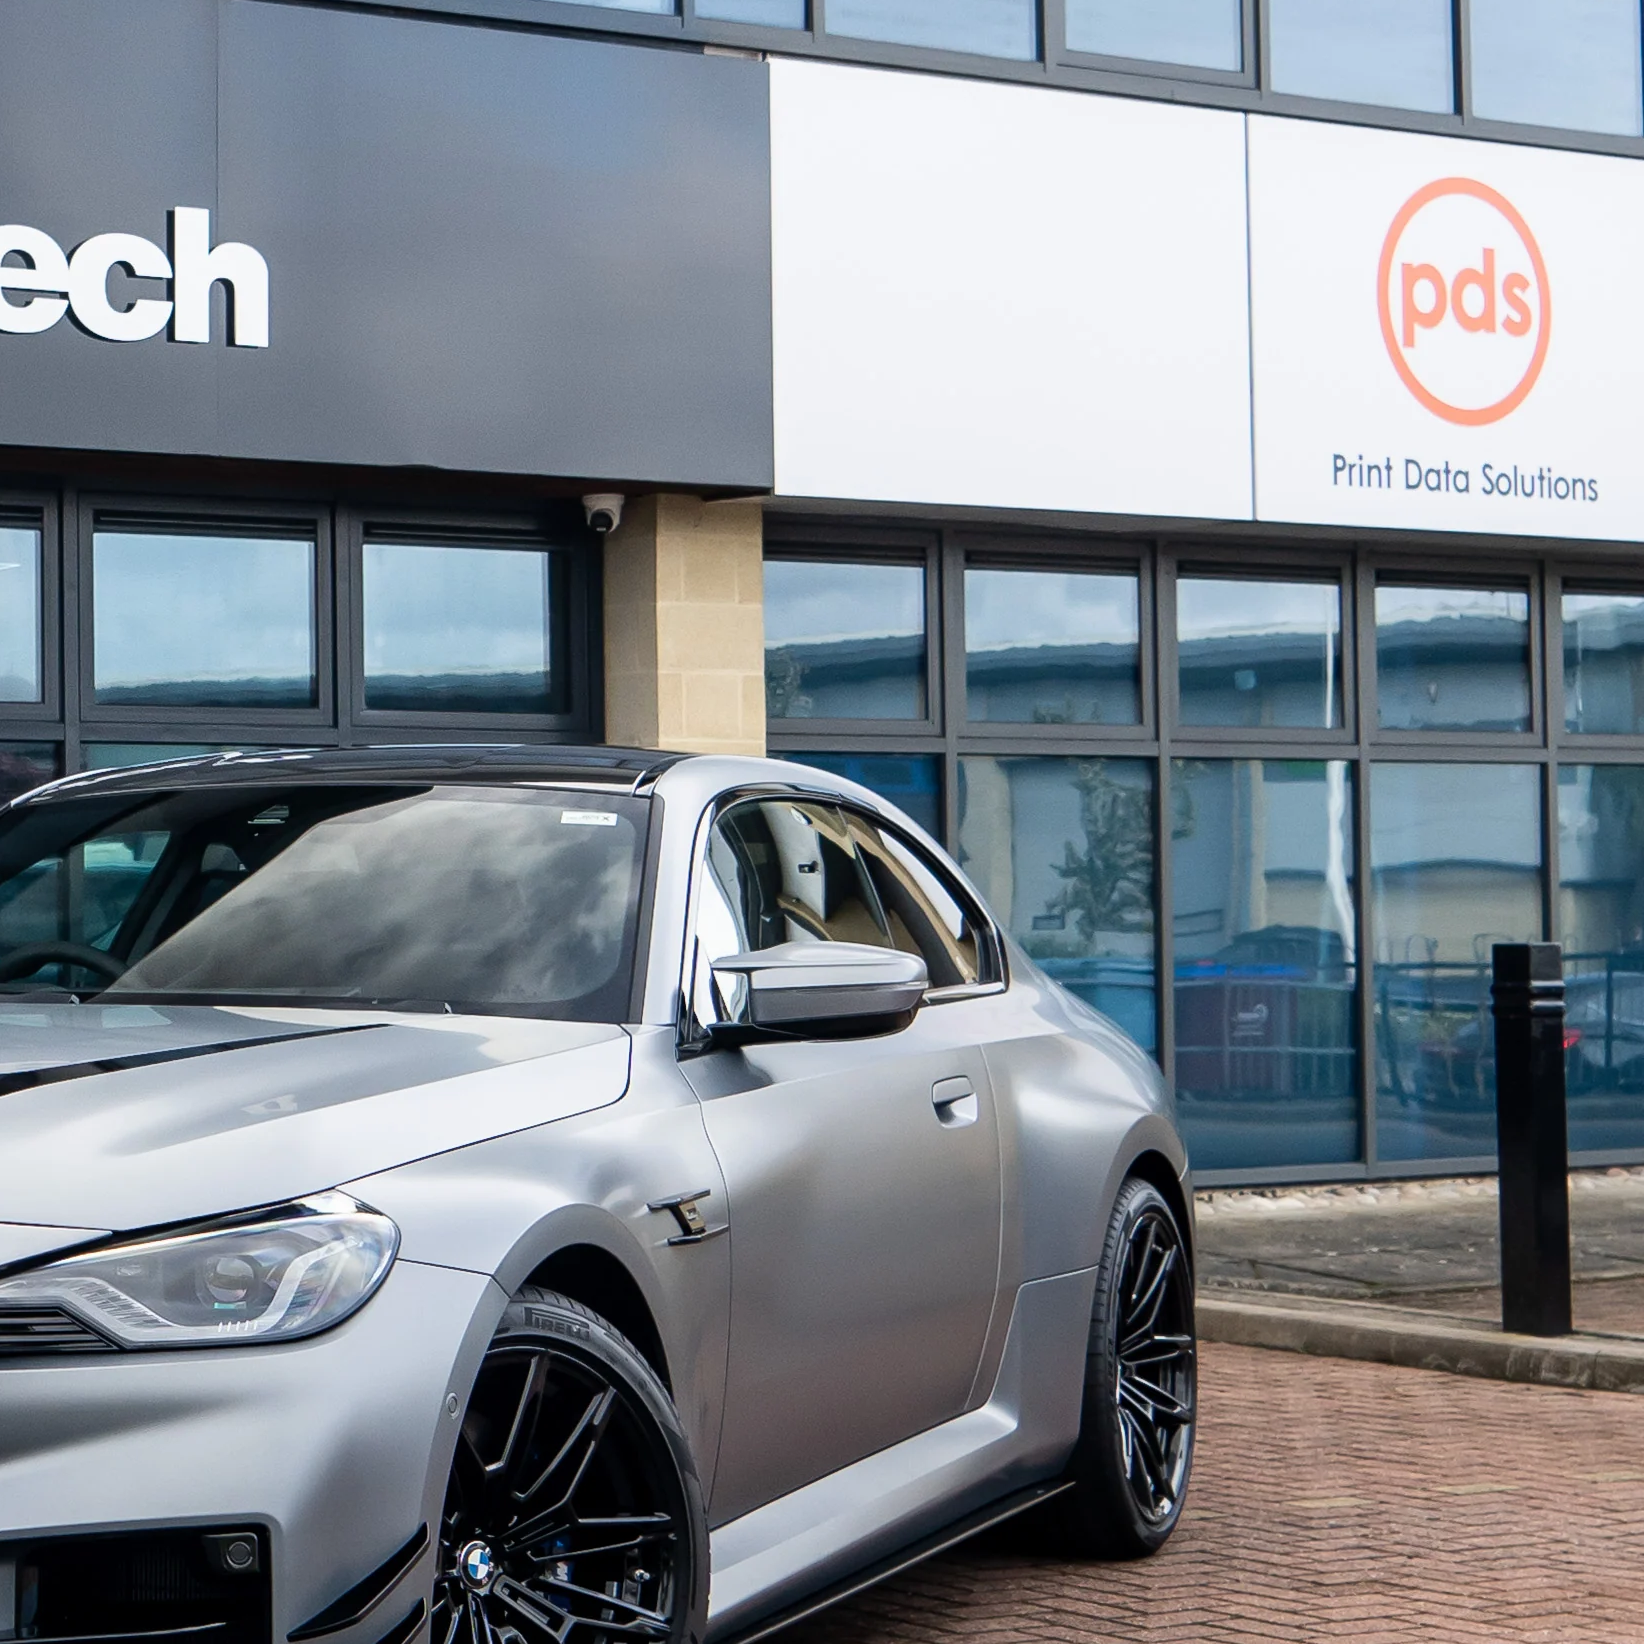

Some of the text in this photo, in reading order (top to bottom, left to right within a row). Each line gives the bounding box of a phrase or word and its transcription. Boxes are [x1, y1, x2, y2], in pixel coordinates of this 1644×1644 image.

[1401, 247, 1533, 348] pds
[1333, 453, 1599, 502] Print Data Solutions
